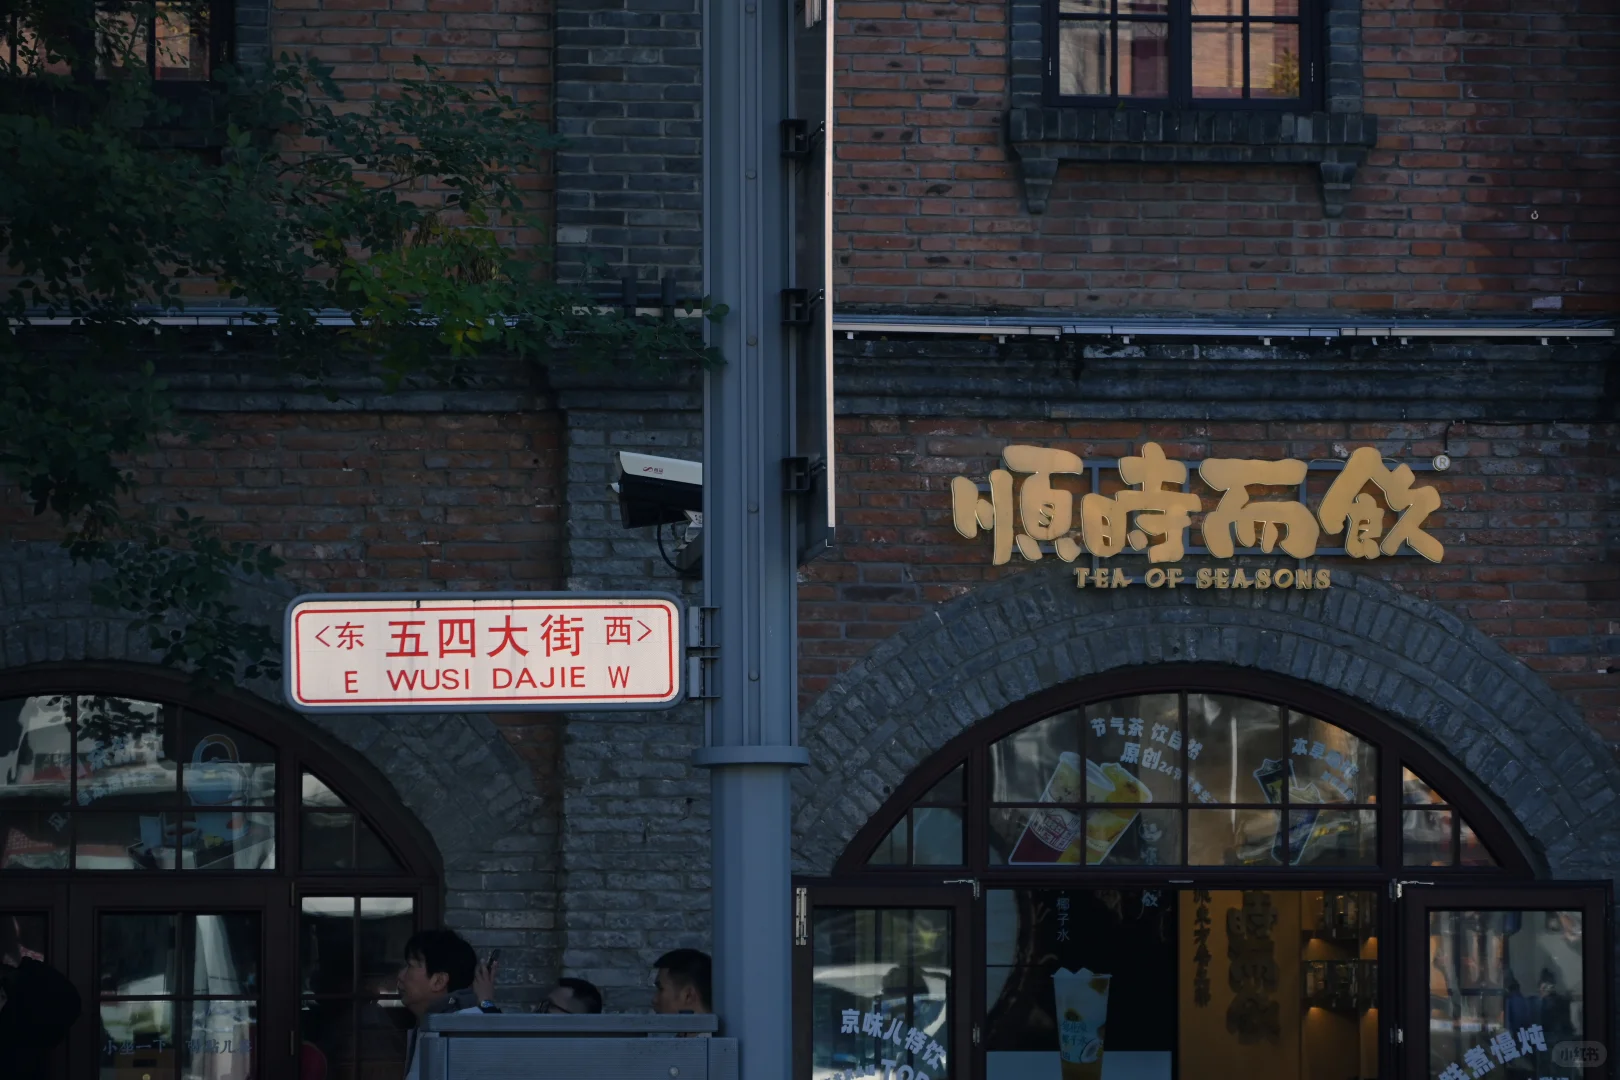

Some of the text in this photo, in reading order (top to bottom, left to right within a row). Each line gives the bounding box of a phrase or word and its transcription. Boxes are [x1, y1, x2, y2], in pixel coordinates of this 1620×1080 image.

[1075, 567, 1334, 590] TEA OF SEASONS
[336, 613, 634, 659] 东 五四大街 西
[344, 665, 631, 694] E WUSI DAJIE W
[103, 1039, 167, 1056] 小坐一下
[841, 1008, 946, 1071] 京味儿特饮
